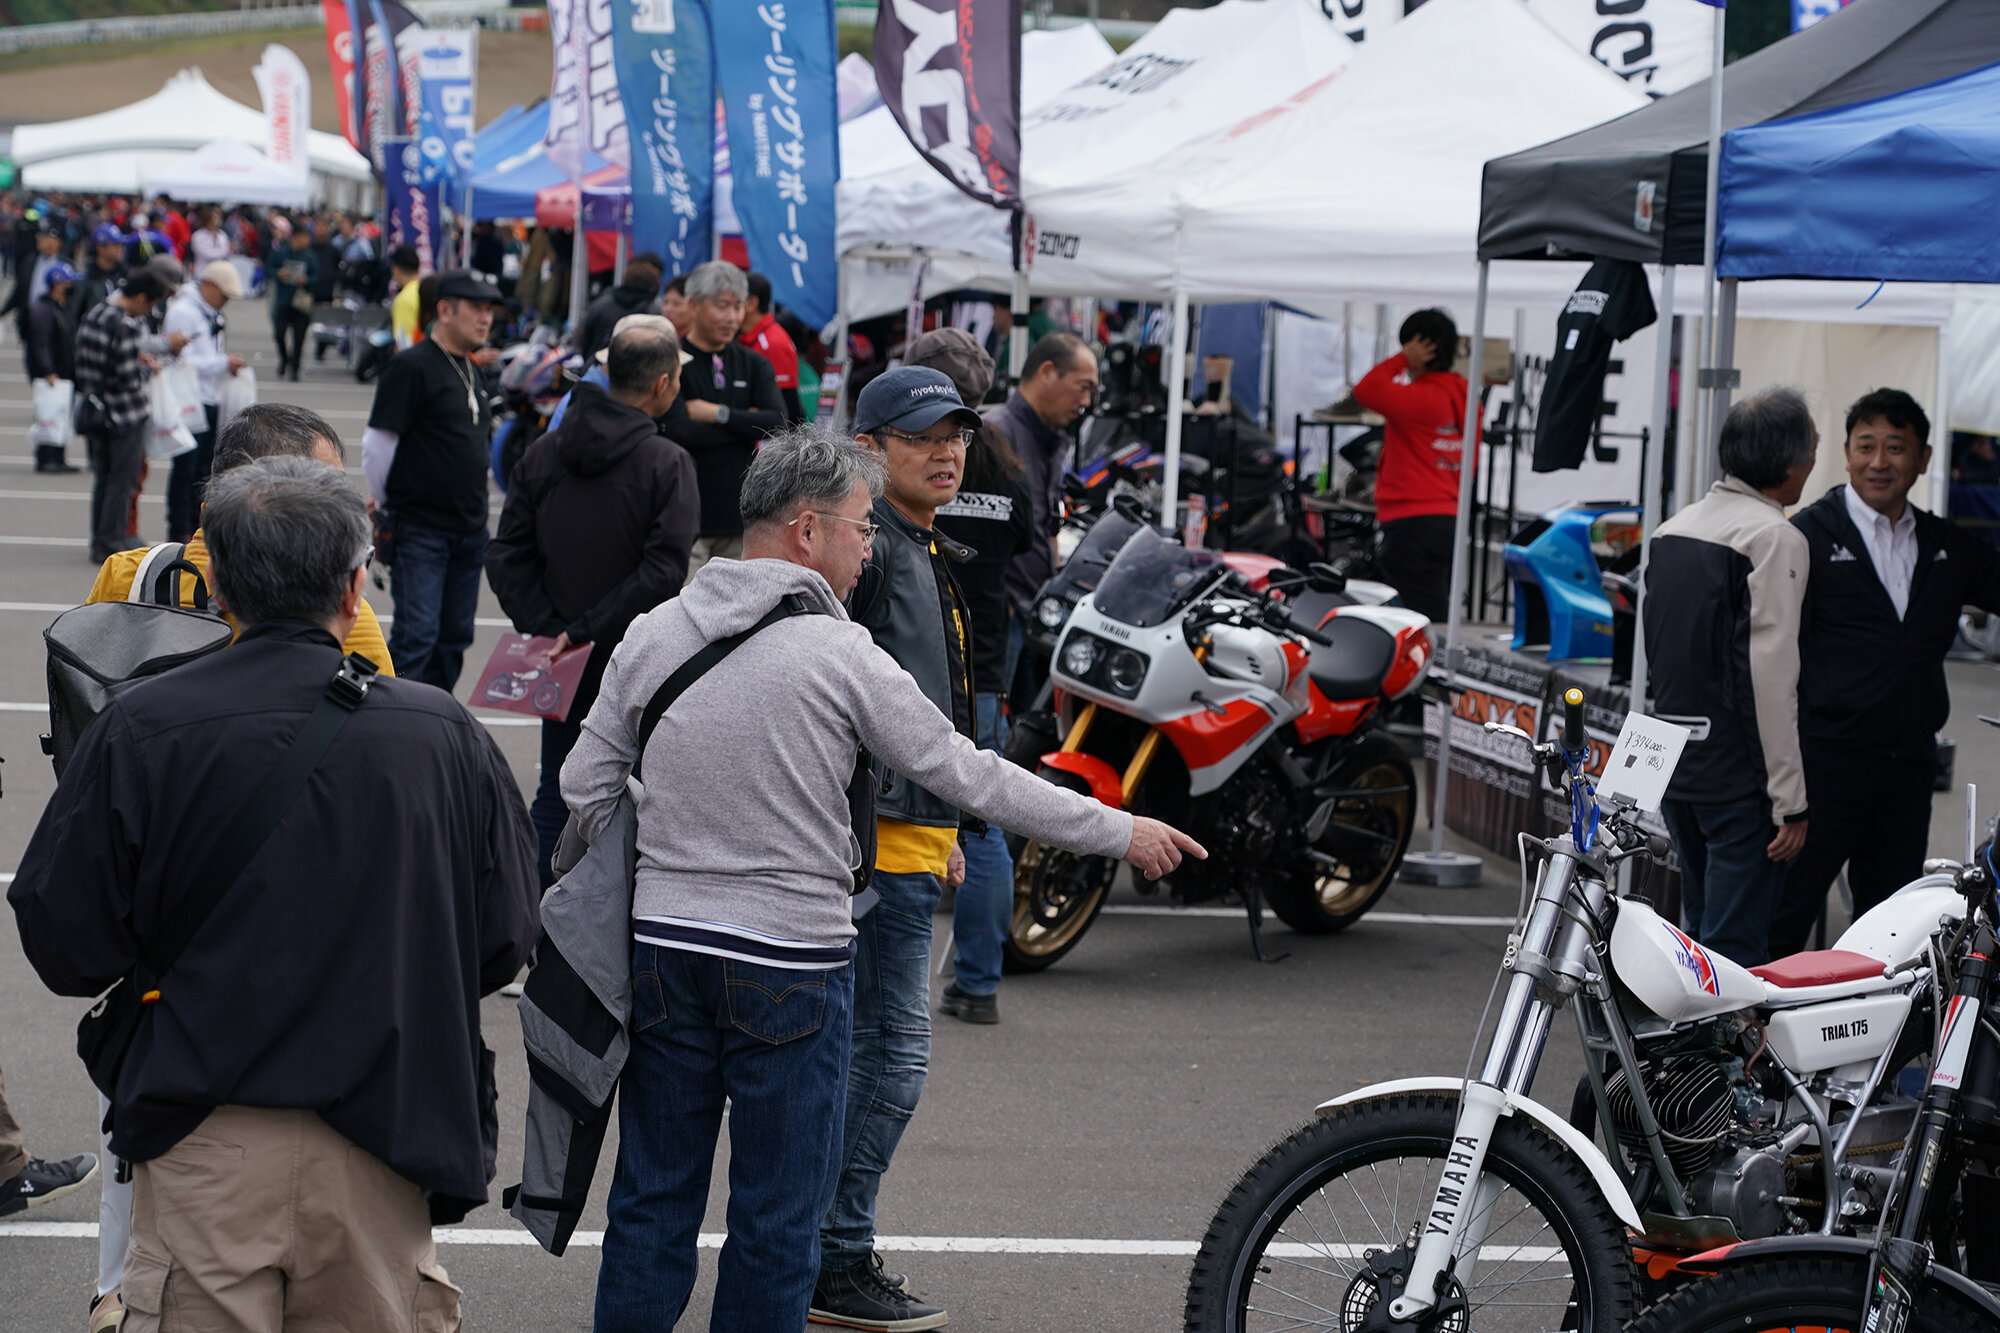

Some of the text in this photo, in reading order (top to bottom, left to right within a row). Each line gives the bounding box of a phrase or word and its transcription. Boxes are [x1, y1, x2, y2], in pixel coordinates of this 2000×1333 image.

[751, 111, 772, 178] NAVITIME
[757, 3, 808, 288] ツーリングサポーター
[910, 384, 934, 397] Hyod
[1100, 621, 1131, 641] YAMAHA
[1674, 949, 1704, 978] YAMAHA
[1821, 1019, 1869, 1042] TRIAL 175
[1932, 1070, 1958, 1083] ctory
[1425, 1136, 1479, 1236] YAMAHA
